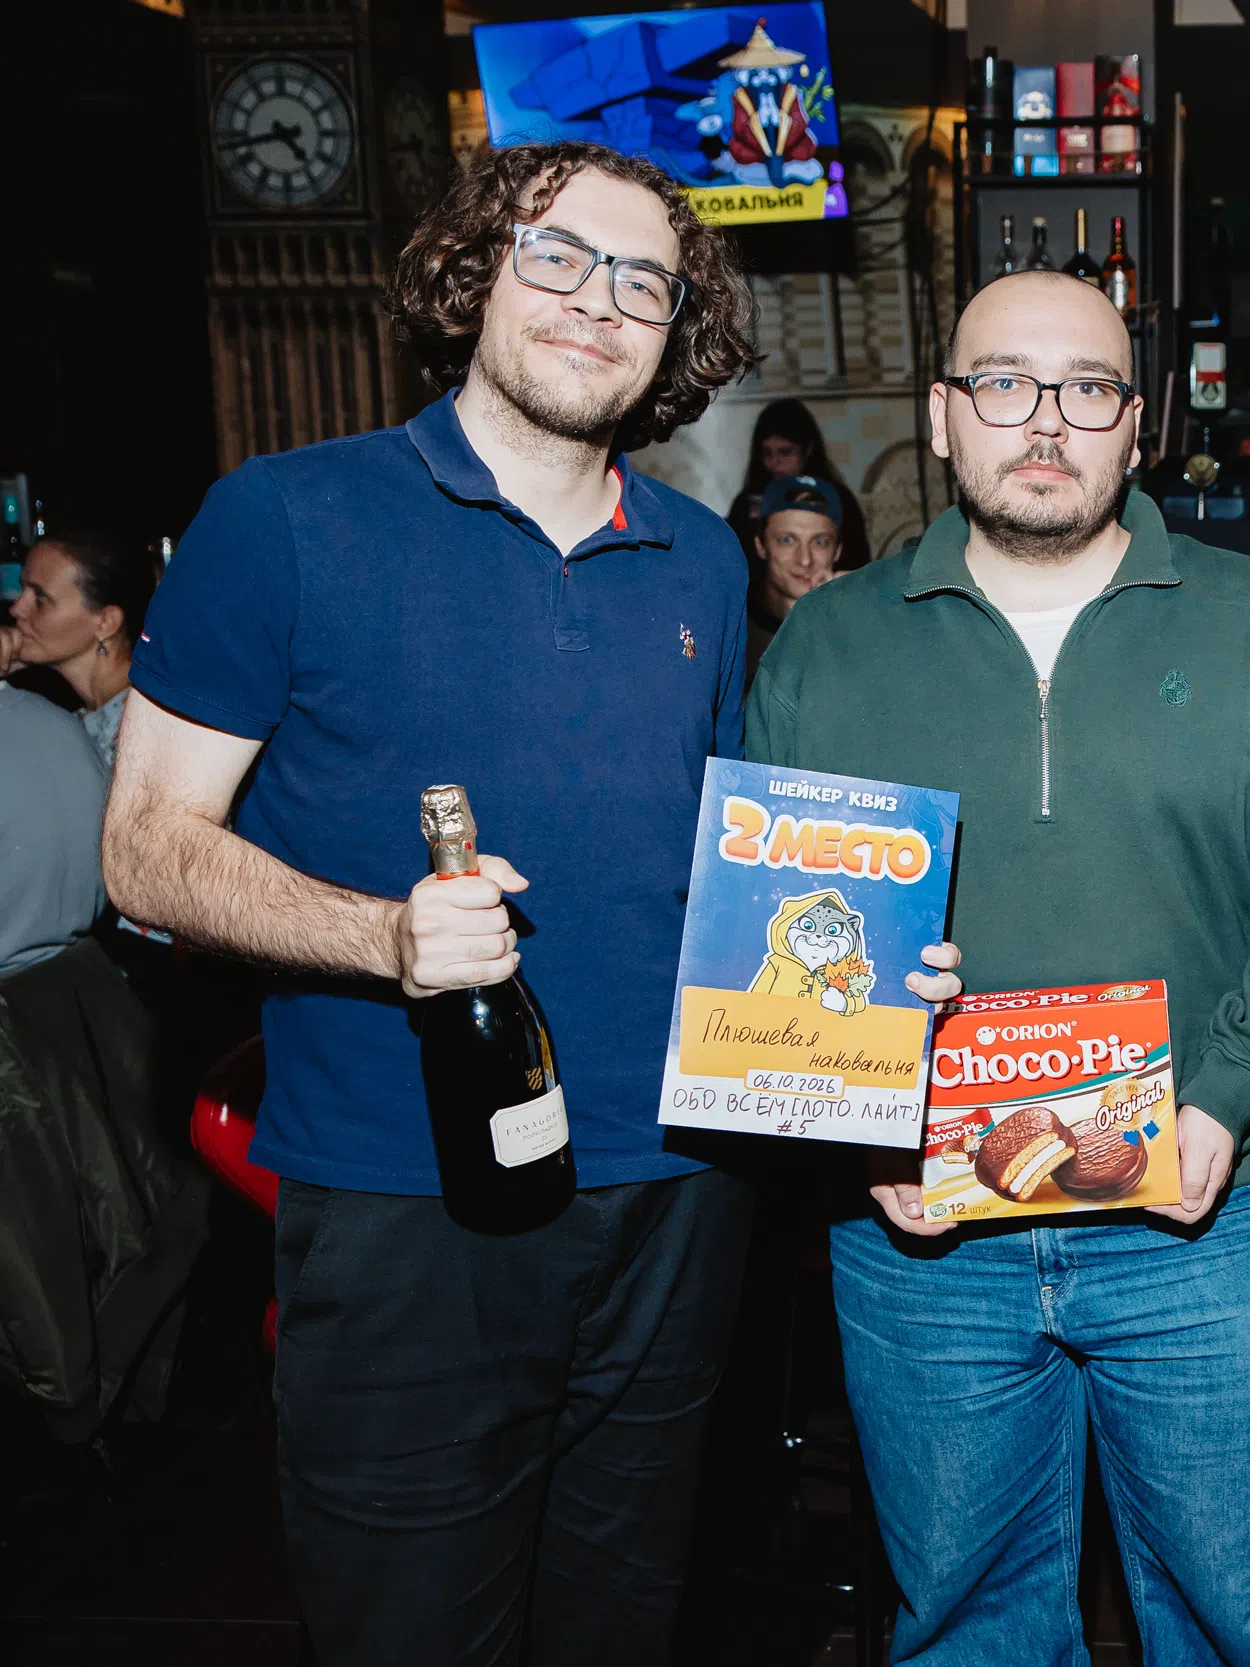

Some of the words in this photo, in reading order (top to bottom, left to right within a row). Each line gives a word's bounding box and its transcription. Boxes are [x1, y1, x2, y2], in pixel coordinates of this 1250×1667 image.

[695, 191, 804, 212] КОВАЛЬНЯ
[768, 779, 843, 804] ШЕЙКЕР
[848, 791, 898, 812] КВИЗ
[723, 800, 767, 860] 2
[768, 818, 927, 879] МЕСТО
[1097, 984, 1152, 1002] Original
[702, 1008, 821, 1049] Плюшевая
[808, 1049, 916, 1077] наковальня
[752, 1073, 836, 1095] 06.10.2026
[1096, 1080, 1166, 1131] Original
[948, 1202, 967, 1216] 12
[970, 1204, 992, 1216] штук
